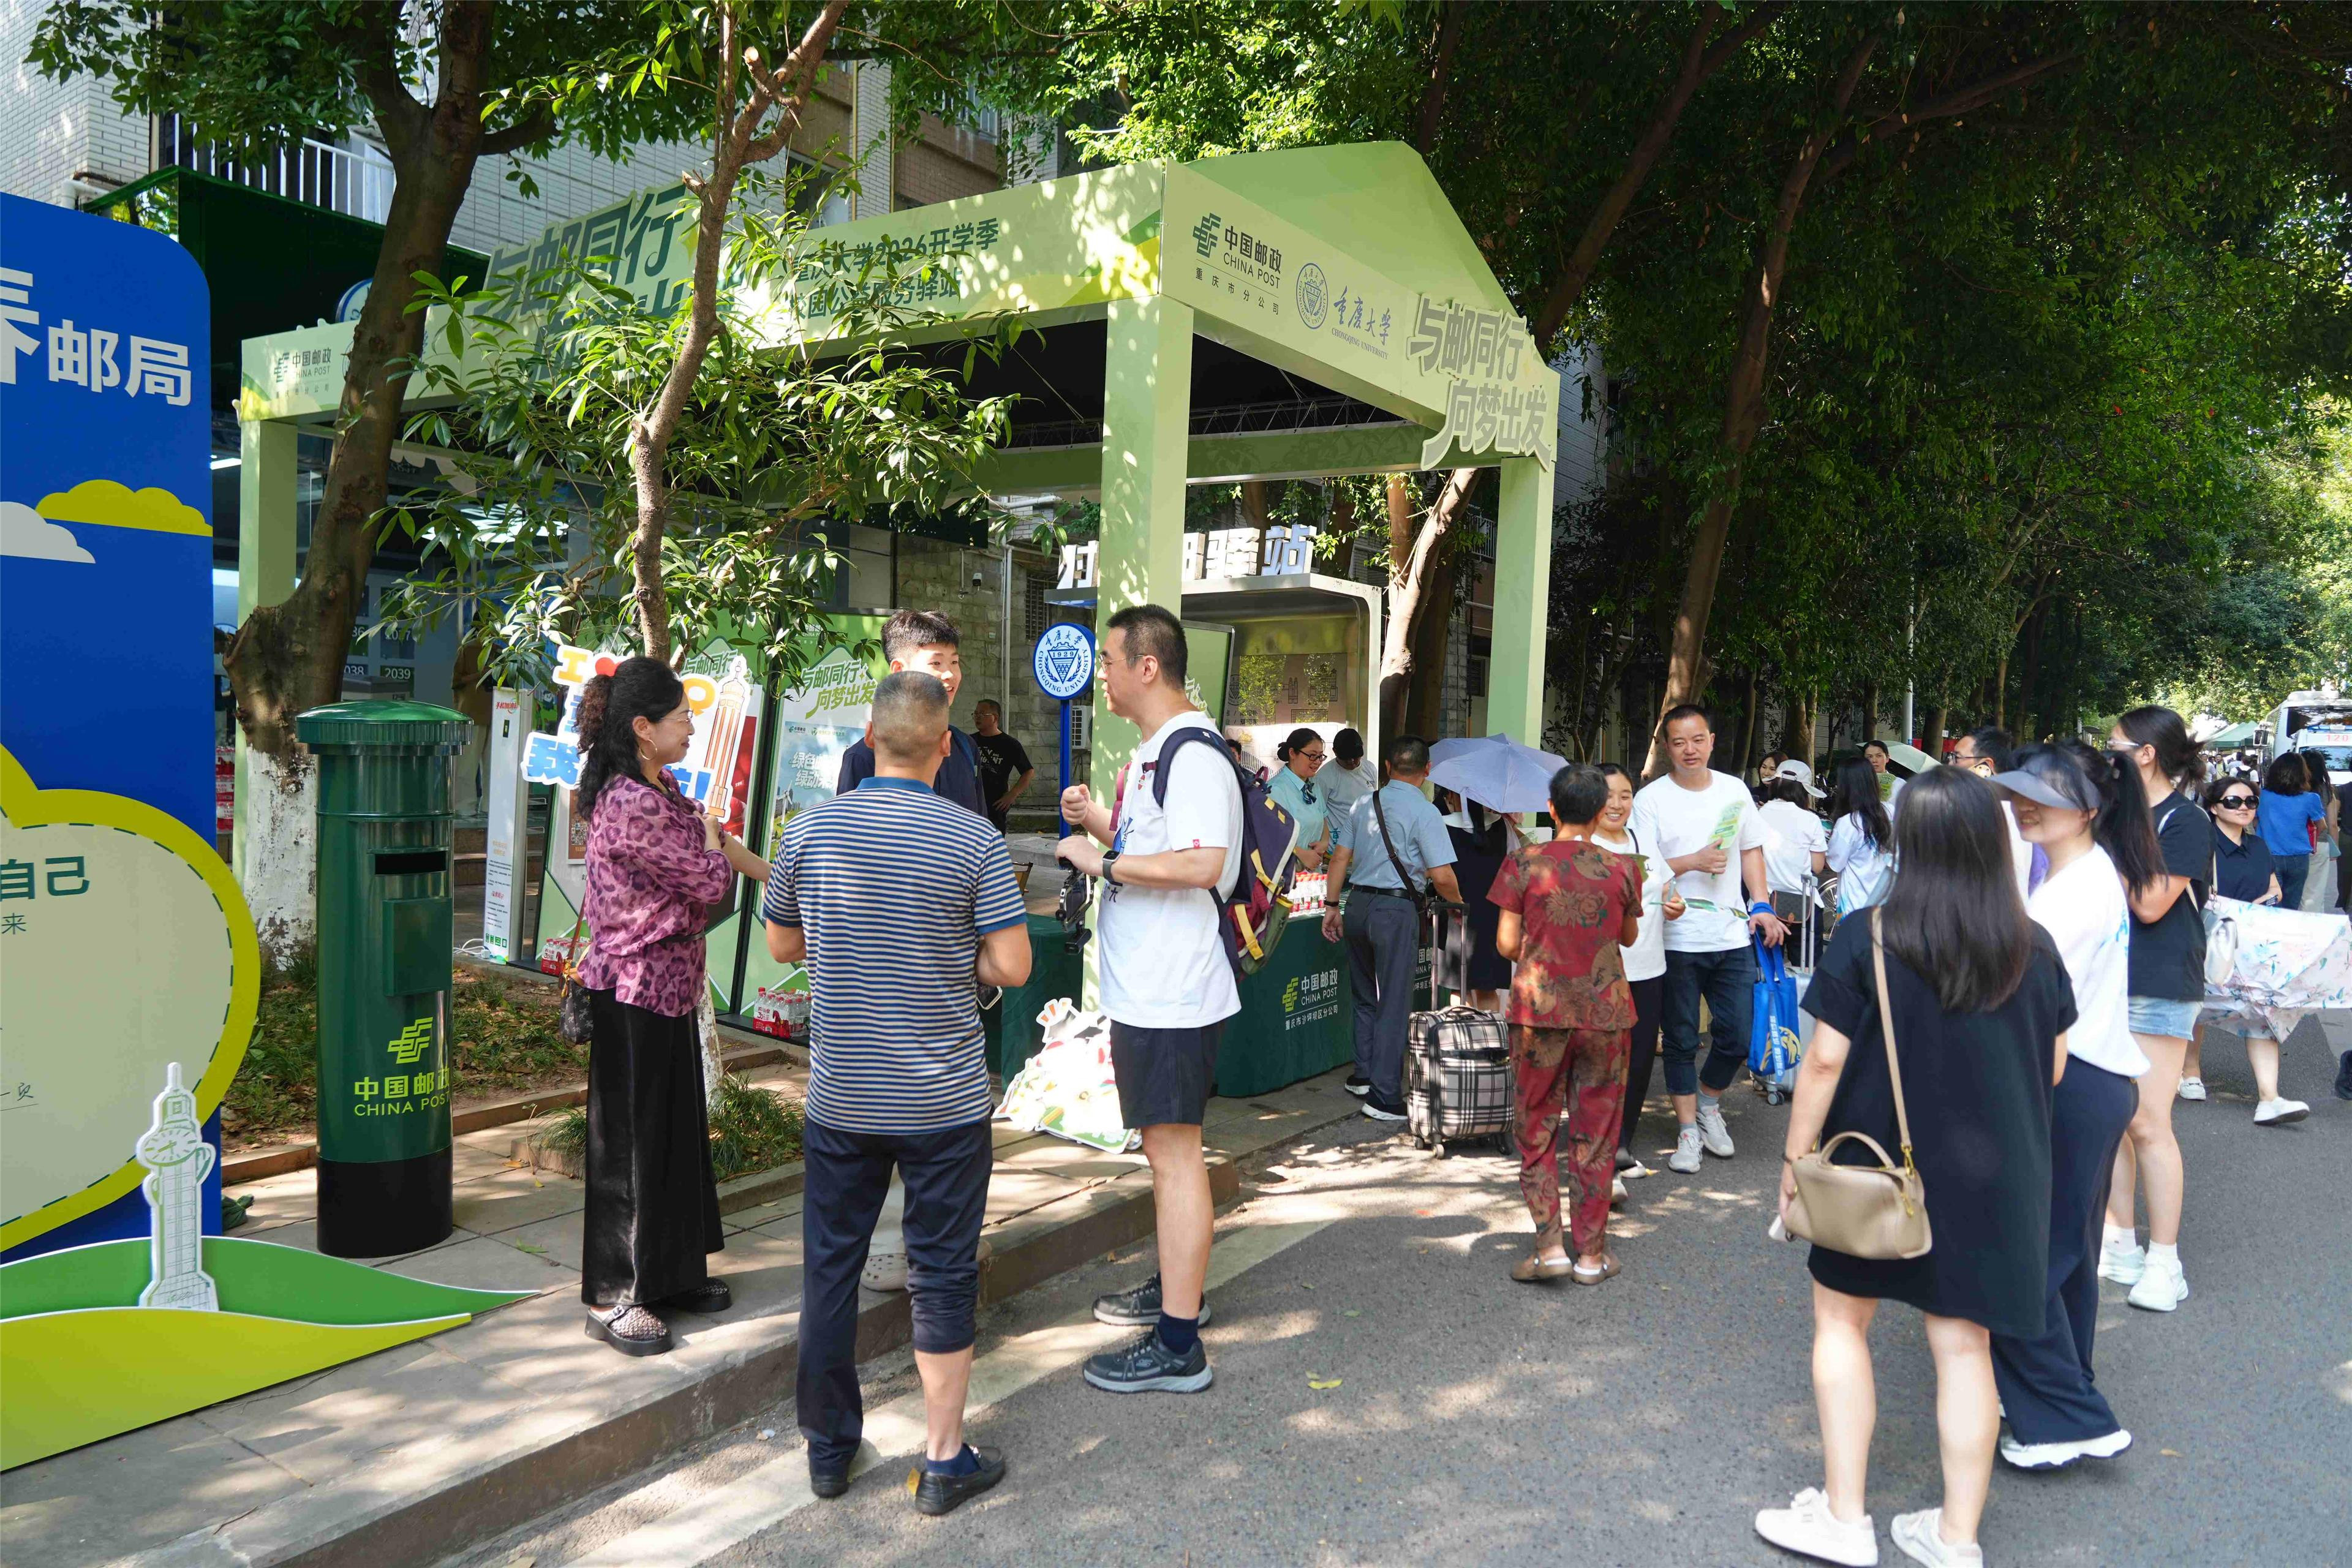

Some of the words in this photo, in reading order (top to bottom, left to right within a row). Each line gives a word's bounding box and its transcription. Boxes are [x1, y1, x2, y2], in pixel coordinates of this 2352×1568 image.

[1225, 225, 1282, 275] 中国邮政
[1224, 252, 1254, 277] CHINA
[1257, 268, 1281, 288] POST
[1196, 267, 1280, 315] 重庆市分公司
[1332, 327, 1360, 347] CHONGQING
[1361, 341, 1389, 360] UNIVERSITY
[1410, 298, 1525, 382] 与邮同行
[292, 347, 331, 368] 中国邮政
[296, 368, 312, 378] HINA
[314, 366, 331, 377] POST
[1423, 379, 1552, 469] 向梦出发
[385, 668, 411, 680] 2039
[801, 660, 861, 690] 与邮同行
[1038, 650, 1061, 693] CHONGQING
[1065, 649, 1089, 693] UNIVERSITY
[805, 681, 878, 720] 向梦出发
[0, 856, 90, 902] 自己
[1, 912, 27, 935] 来
[1301, 968, 1338, 994] 中国邮政
[1301, 992, 1321, 1006] CHINA
[1322, 987, 1338, 1000] POST
[1285, 1004, 1338, 1030] 重庆市沙坪坝区分公司
[354, 1068, 450, 1101] 中国邮政
[354, 1101, 414, 1117] CHINA
[421, 1091, 450, 1110] POST
